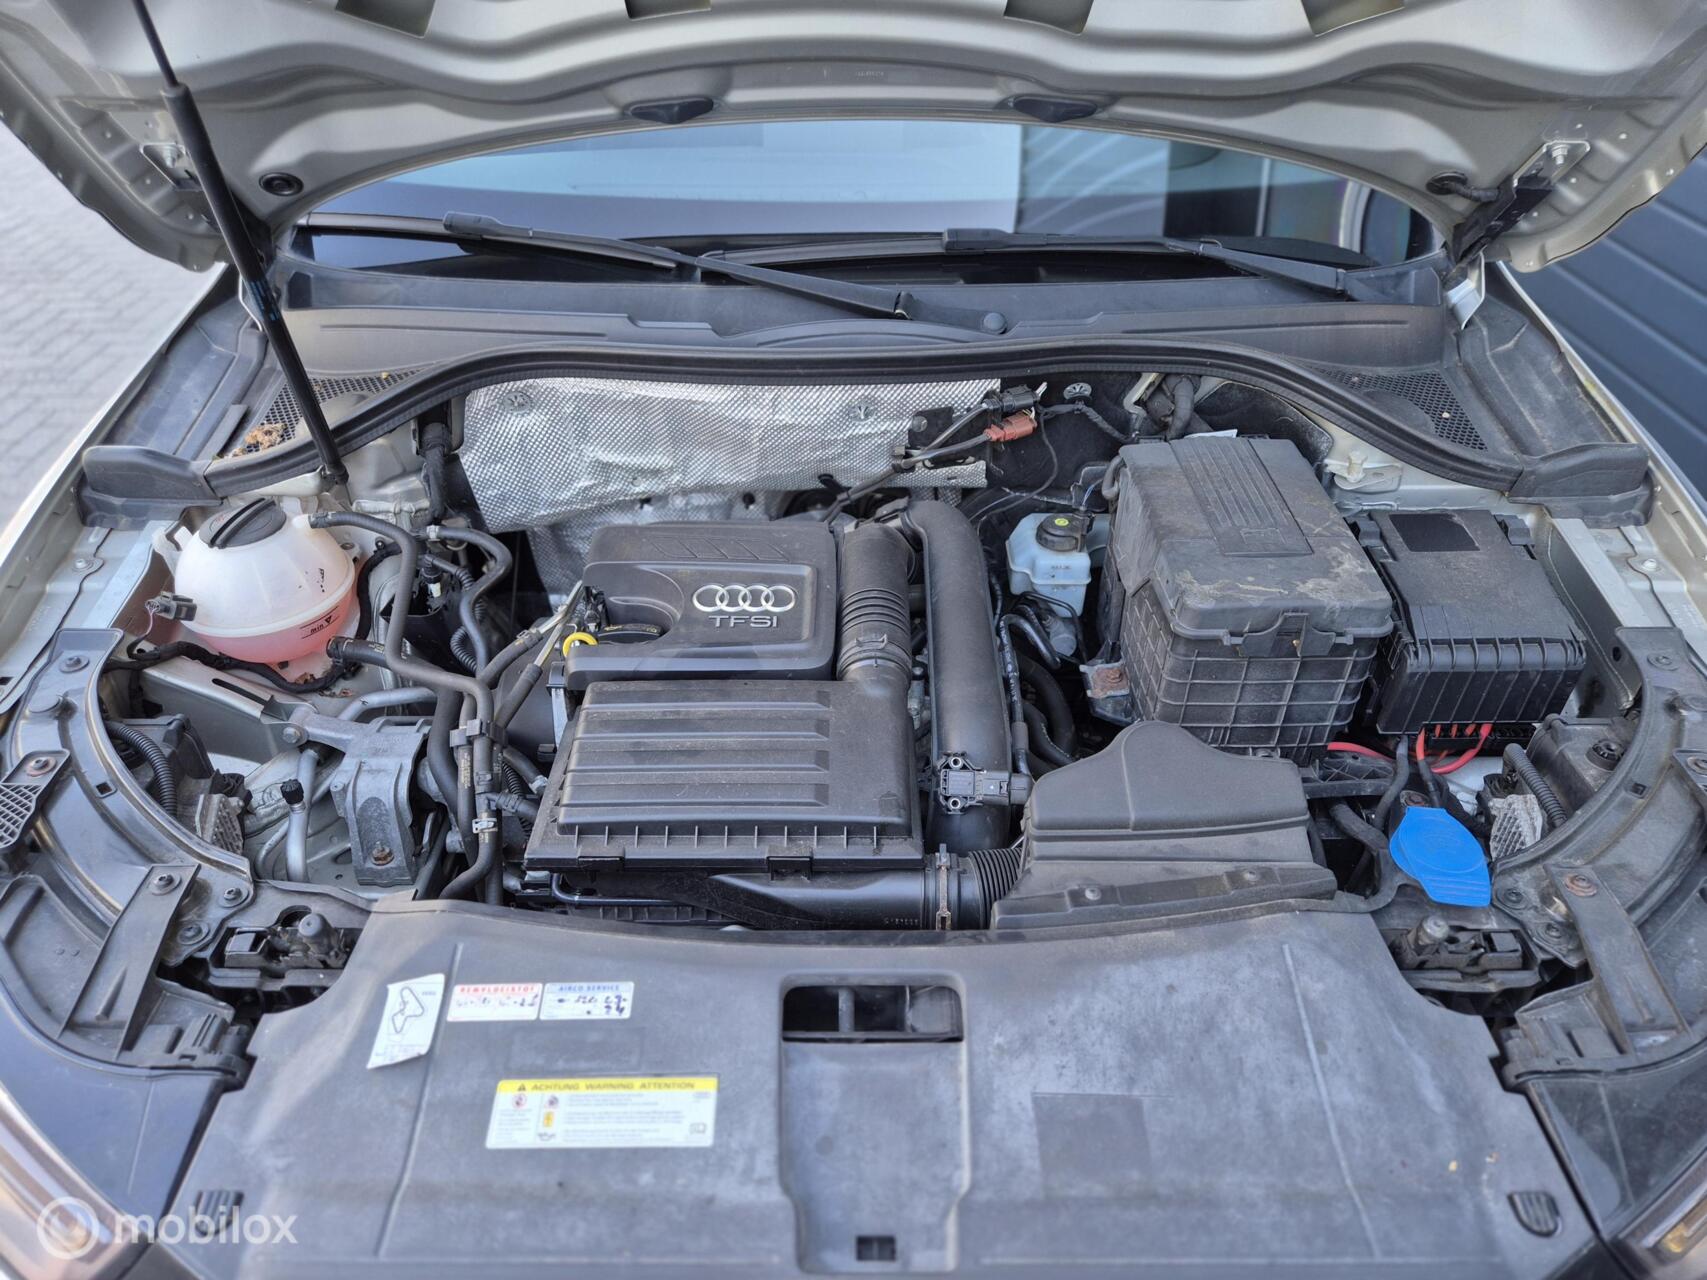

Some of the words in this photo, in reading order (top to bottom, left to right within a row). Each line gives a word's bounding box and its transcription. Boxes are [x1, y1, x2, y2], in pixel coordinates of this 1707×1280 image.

[708, 615, 779, 628] TFSI
[530, 1082, 581, 1091] ACHTUNG
[585, 1082, 635, 1090] WARNING
[639, 1081, 696, 1090] ATTENTION
